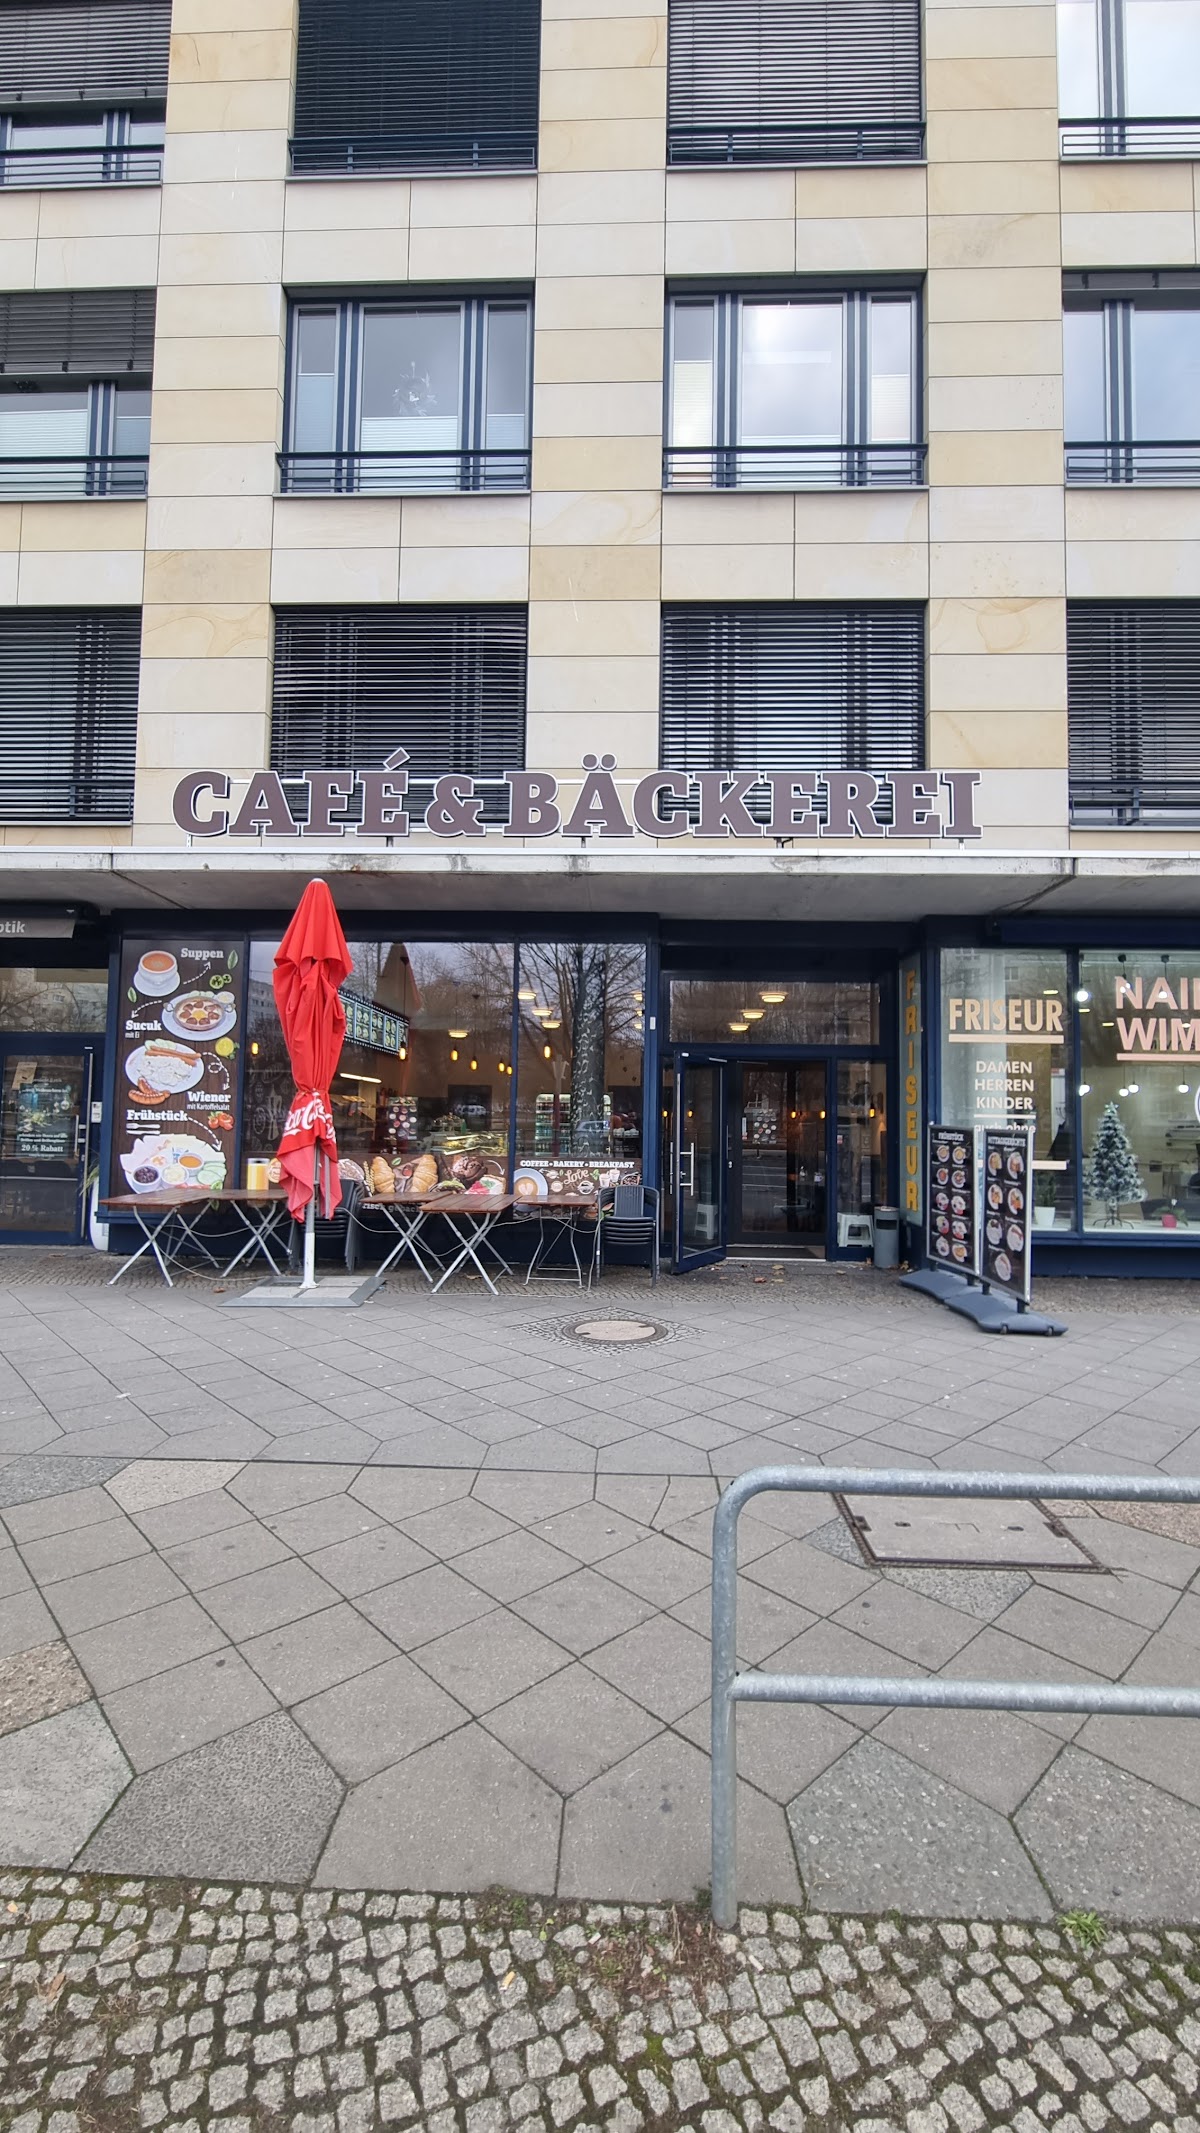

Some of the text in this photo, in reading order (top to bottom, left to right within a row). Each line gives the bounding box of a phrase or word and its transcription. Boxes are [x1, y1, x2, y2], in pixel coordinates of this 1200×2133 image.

[172, 747, 984, 840] CAFÉ & BÄCKEREI
[180, 947, 224, 959] Suppen
[949, 998, 1064, 1032] FRISEUR
[126, 1019, 162, 1031] Sucuk
[125, 1031, 135, 1039] mit
[976, 1060, 1033, 1074] DAMEN
[905, 970, 918, 1212] FRISEUR
[974, 1079, 1035, 1092] HERREN
[187, 1091, 232, 1103] Wiener
[976, 1096, 1034, 1110] KINDER
[197, 1103, 230, 1111] Kartoffelsalat
[127, 1109, 189, 1122] Frühstück
[21, 1144, 31, 1152] 20
[40, 1144, 64, 1153] Rabatt
[553, 1160, 585, 1168] BAKERY
[589, 1161, 635, 1169] BREAKFAST
[563, 1168, 590, 1185] Love
